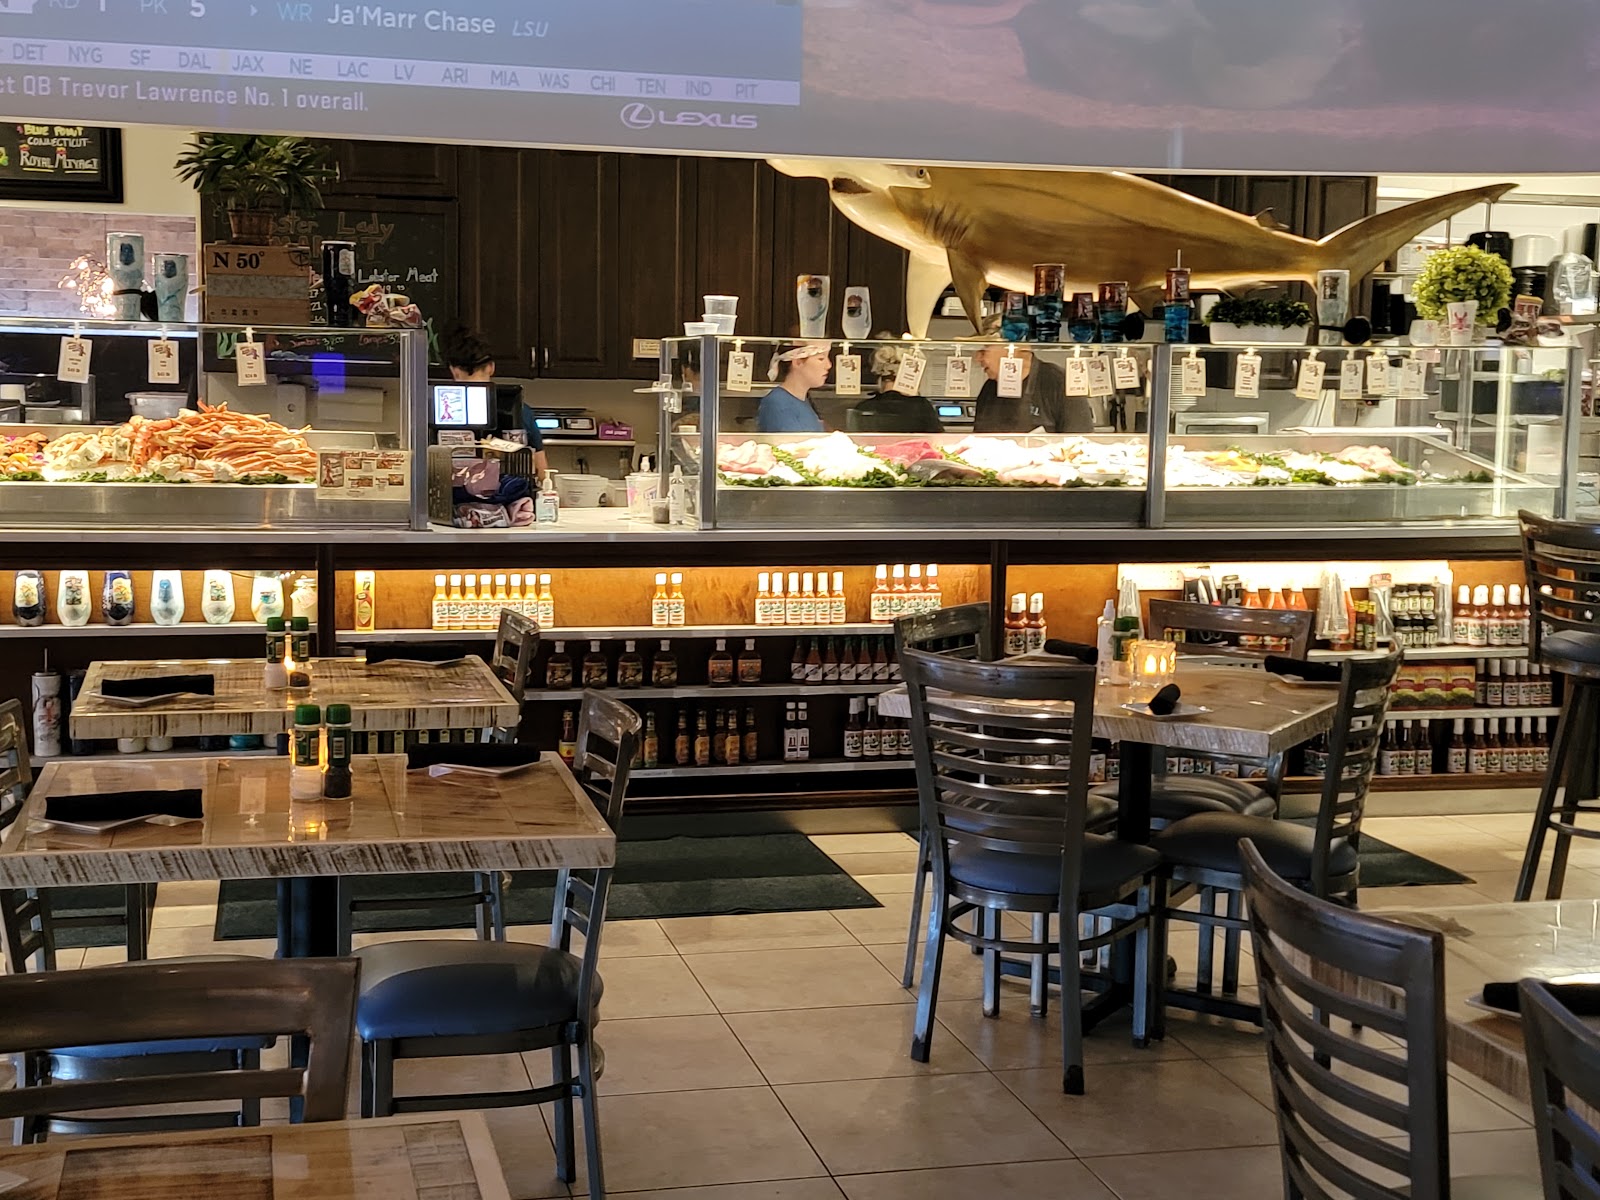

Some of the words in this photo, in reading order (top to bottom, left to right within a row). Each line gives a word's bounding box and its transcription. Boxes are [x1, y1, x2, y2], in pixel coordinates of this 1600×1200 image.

[140, 0, 168, 14] PK
[189, 0, 206, 18] 5
[277, 3, 313, 22] WR
[327, 4, 417, 29] Ja'Marr
[424, 10, 496, 34] Chase
[511, 19, 549, 38] LSU
[12, 43, 48, 61] DET
[68, 47, 103, 63] NYG
[130, 49, 150, 66] SF
[178, 51, 211, 70] DAL
[231, 55, 265, 73] JAX
[289, 58, 313, 76] NE
[337, 61, 369, 78] LAC
[394, 64, 415, 81] LV
[441, 67, 468, 84] ARI
[490, 70, 520, 87] MIA
[538, 72, 570, 90] WAS
[590, 75, 616, 92] CHI
[23, 76, 51, 97] QB
[59, 77, 129, 100] Trevor
[136, 80, 237, 105] Lawrence
[244, 86, 276, 107] No.
[282, 89, 288, 107] 1
[296, 91, 369, 112] overall.
[636, 78, 667, 95] TEN
[685, 80, 713, 97] IND
[735, 83, 759, 99] PIT
[658, 110, 758, 129] LEXUS
[23, 124, 50, 136] BLUE
[53, 126, 84, 137] POINT
[19, 150, 56, 169] ROYAL
[54, 152, 100, 170] MIYAGI
[337, 212, 395, 243] Lady
[212, 251, 230, 269] N
[357, 268, 401, 284] Lobster
[405, 266, 439, 283] Meat
